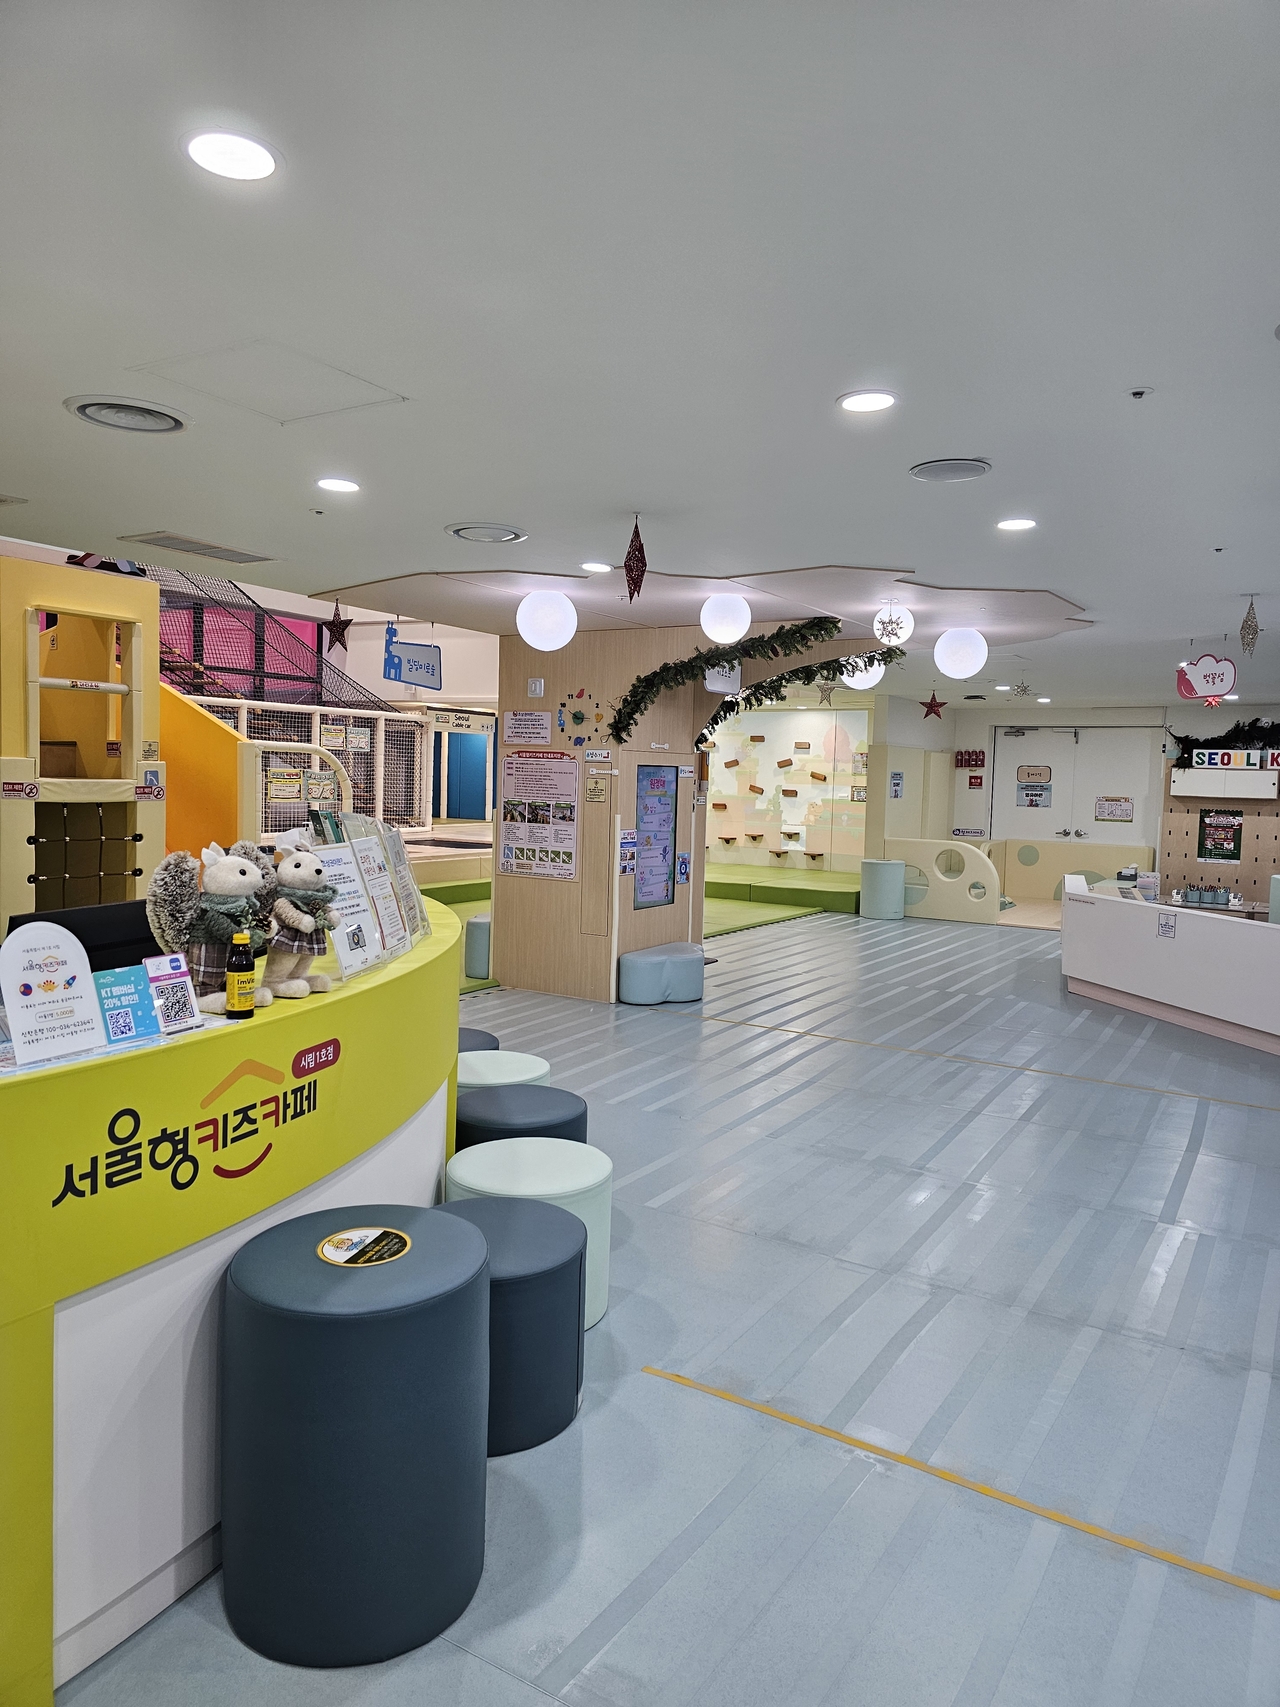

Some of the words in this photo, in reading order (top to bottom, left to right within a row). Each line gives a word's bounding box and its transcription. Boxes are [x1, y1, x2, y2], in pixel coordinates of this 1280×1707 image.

[407, 658, 436, 677] 빌딩미로숲
[1203, 671, 1225, 686] 벚꽃섬
[454, 713, 470, 722] Seoul
[1195, 751, 1257, 767] SEOUL
[22, 959, 68, 973] 서울형키즈카페
[100, 987, 111, 998] KT
[111, 984, 135, 996] 멤버십
[103, 997, 121, 1009] 20%
[21, 1027, 45, 1038] 신한은행
[300, 1052, 315, 1069] 시립
[315, 1045, 334, 1063] 1호점
[52, 1079, 317, 1208] 서울형키즈카페
